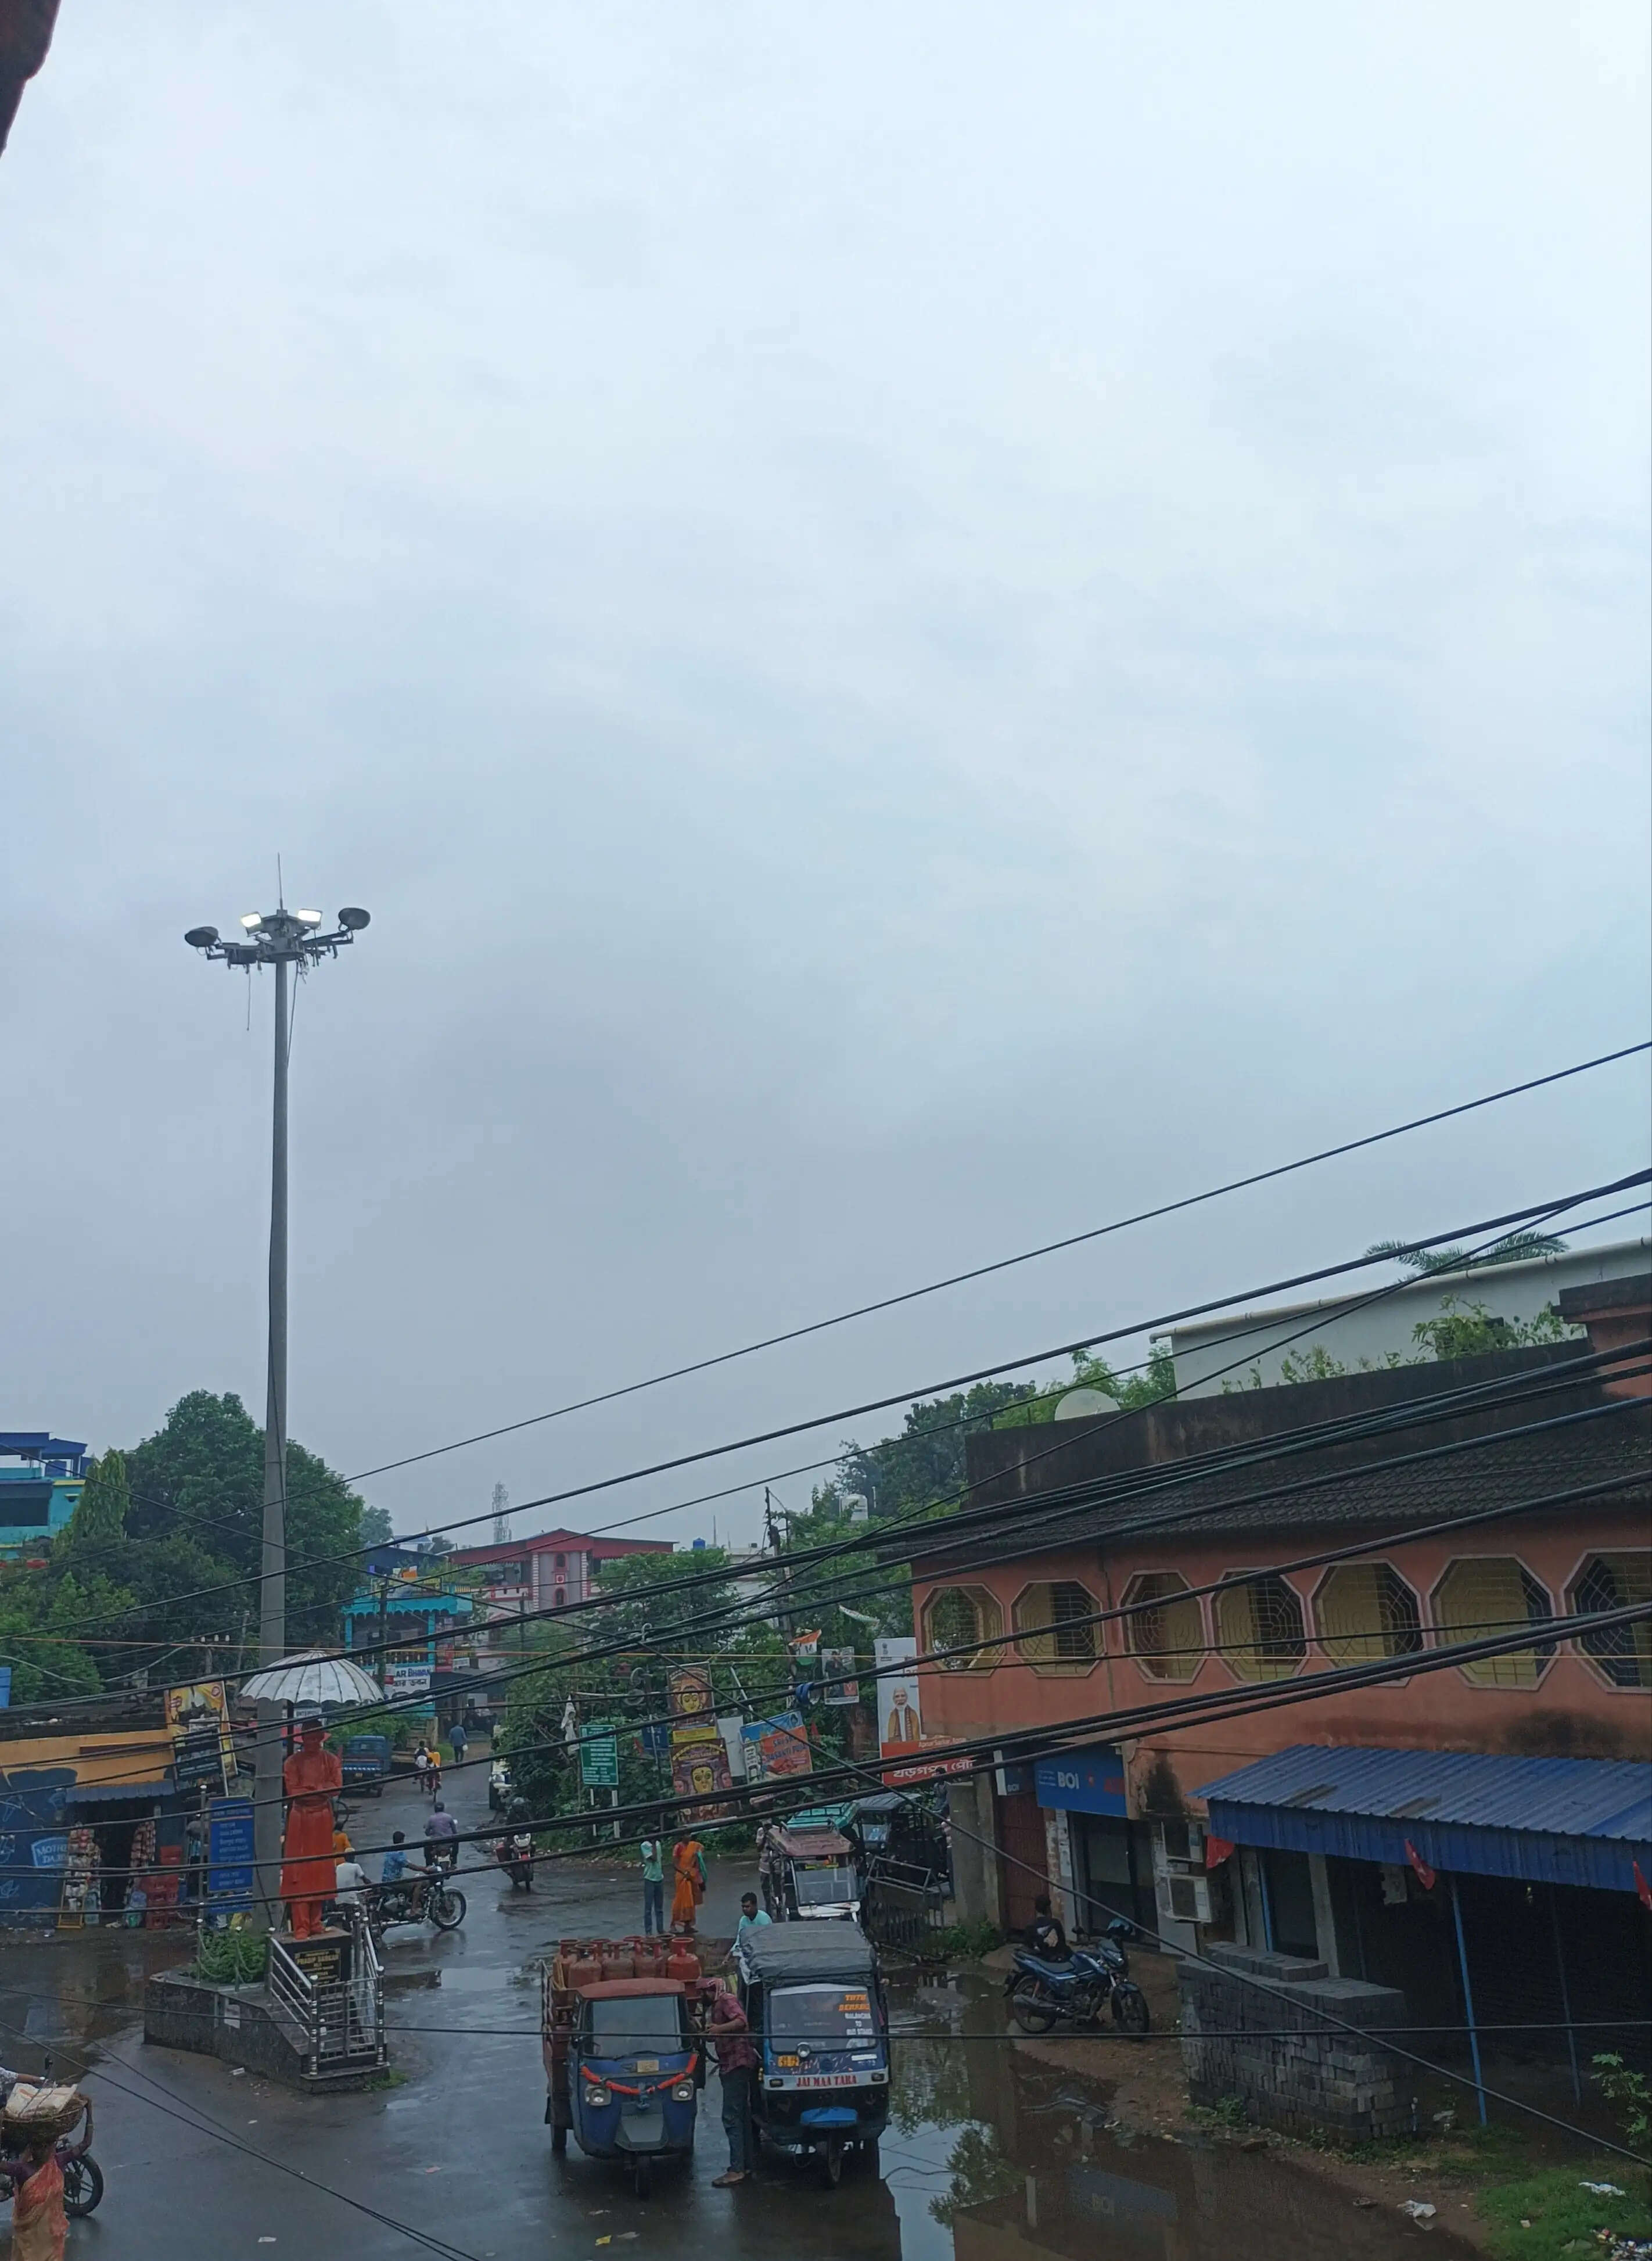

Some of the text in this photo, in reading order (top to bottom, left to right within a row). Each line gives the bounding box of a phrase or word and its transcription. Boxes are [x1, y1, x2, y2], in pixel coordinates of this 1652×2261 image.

[796, 2075, 857, 2087] JAI MAA TARA
